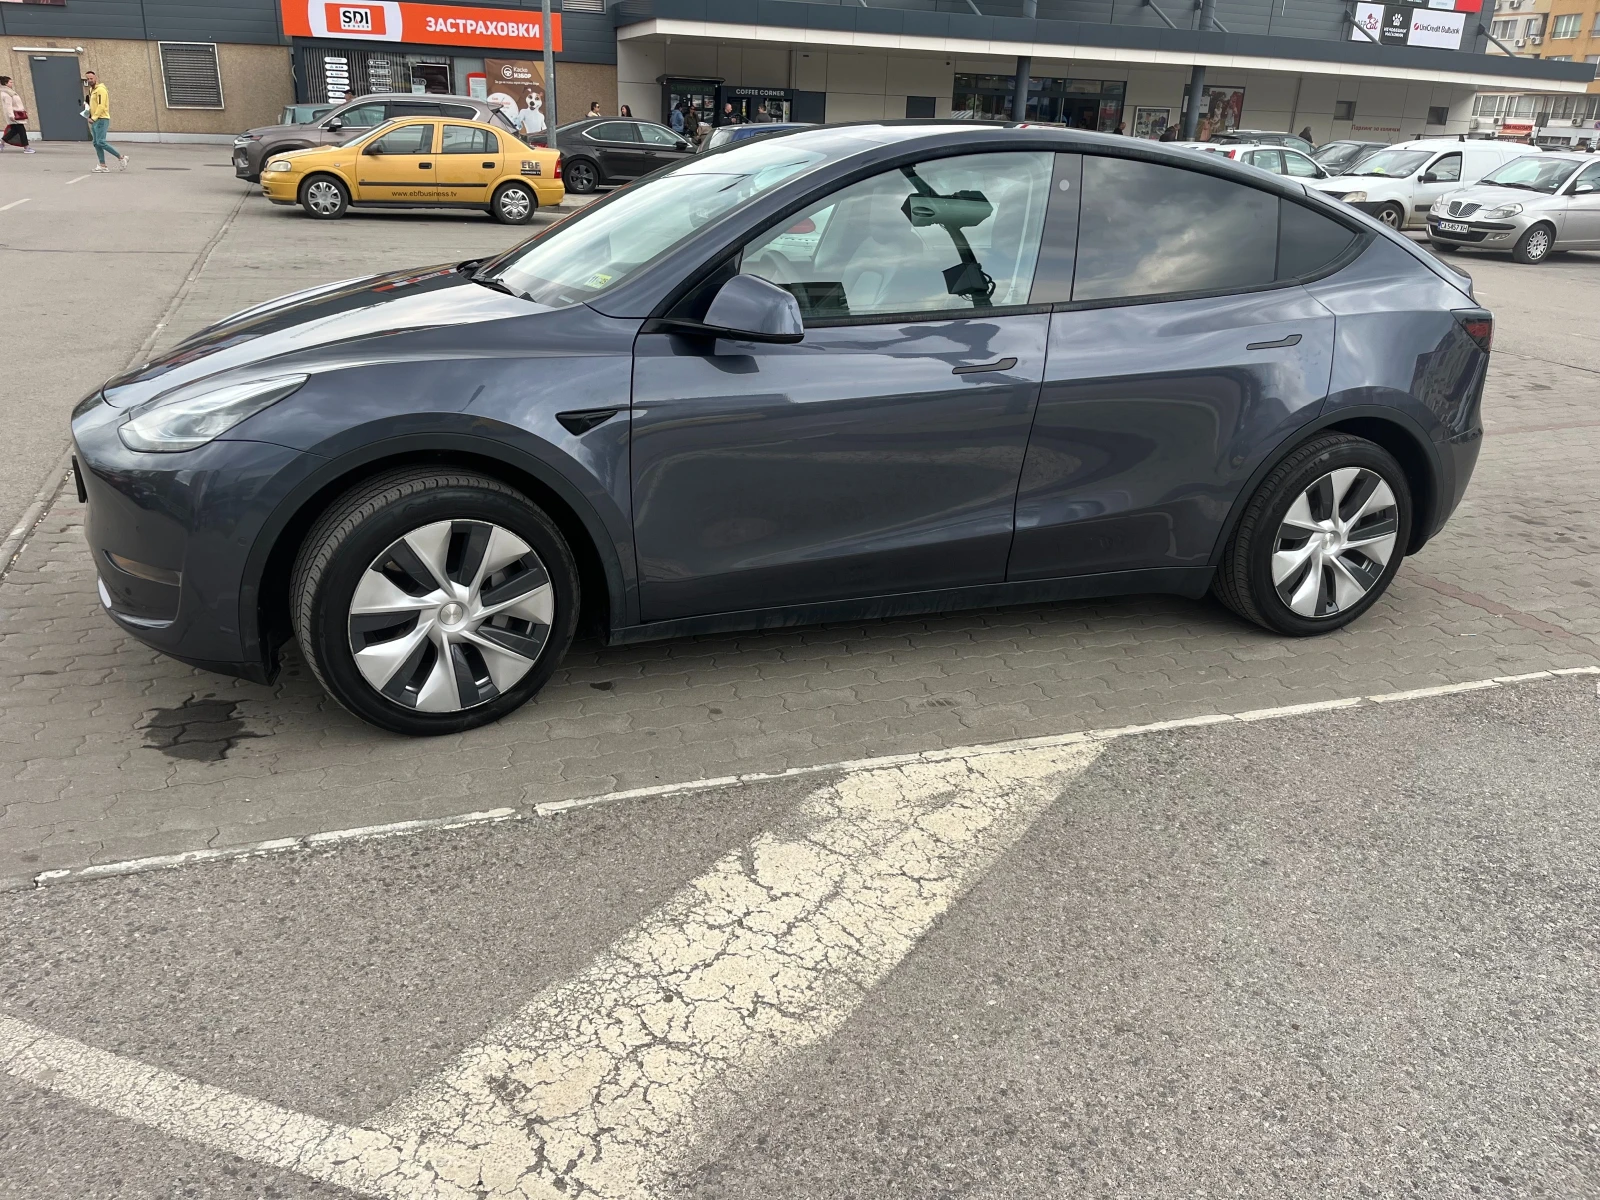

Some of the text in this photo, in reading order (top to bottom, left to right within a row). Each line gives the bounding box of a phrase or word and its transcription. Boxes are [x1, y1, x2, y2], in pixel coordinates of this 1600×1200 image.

[342, 10, 369, 24] SDI
[425, 16, 540, 38] ЗАСТРАХОВКИ
[1420, 23, 1460, 34] UniCredit Bulbank
[521, 161, 540, 170] EBF
